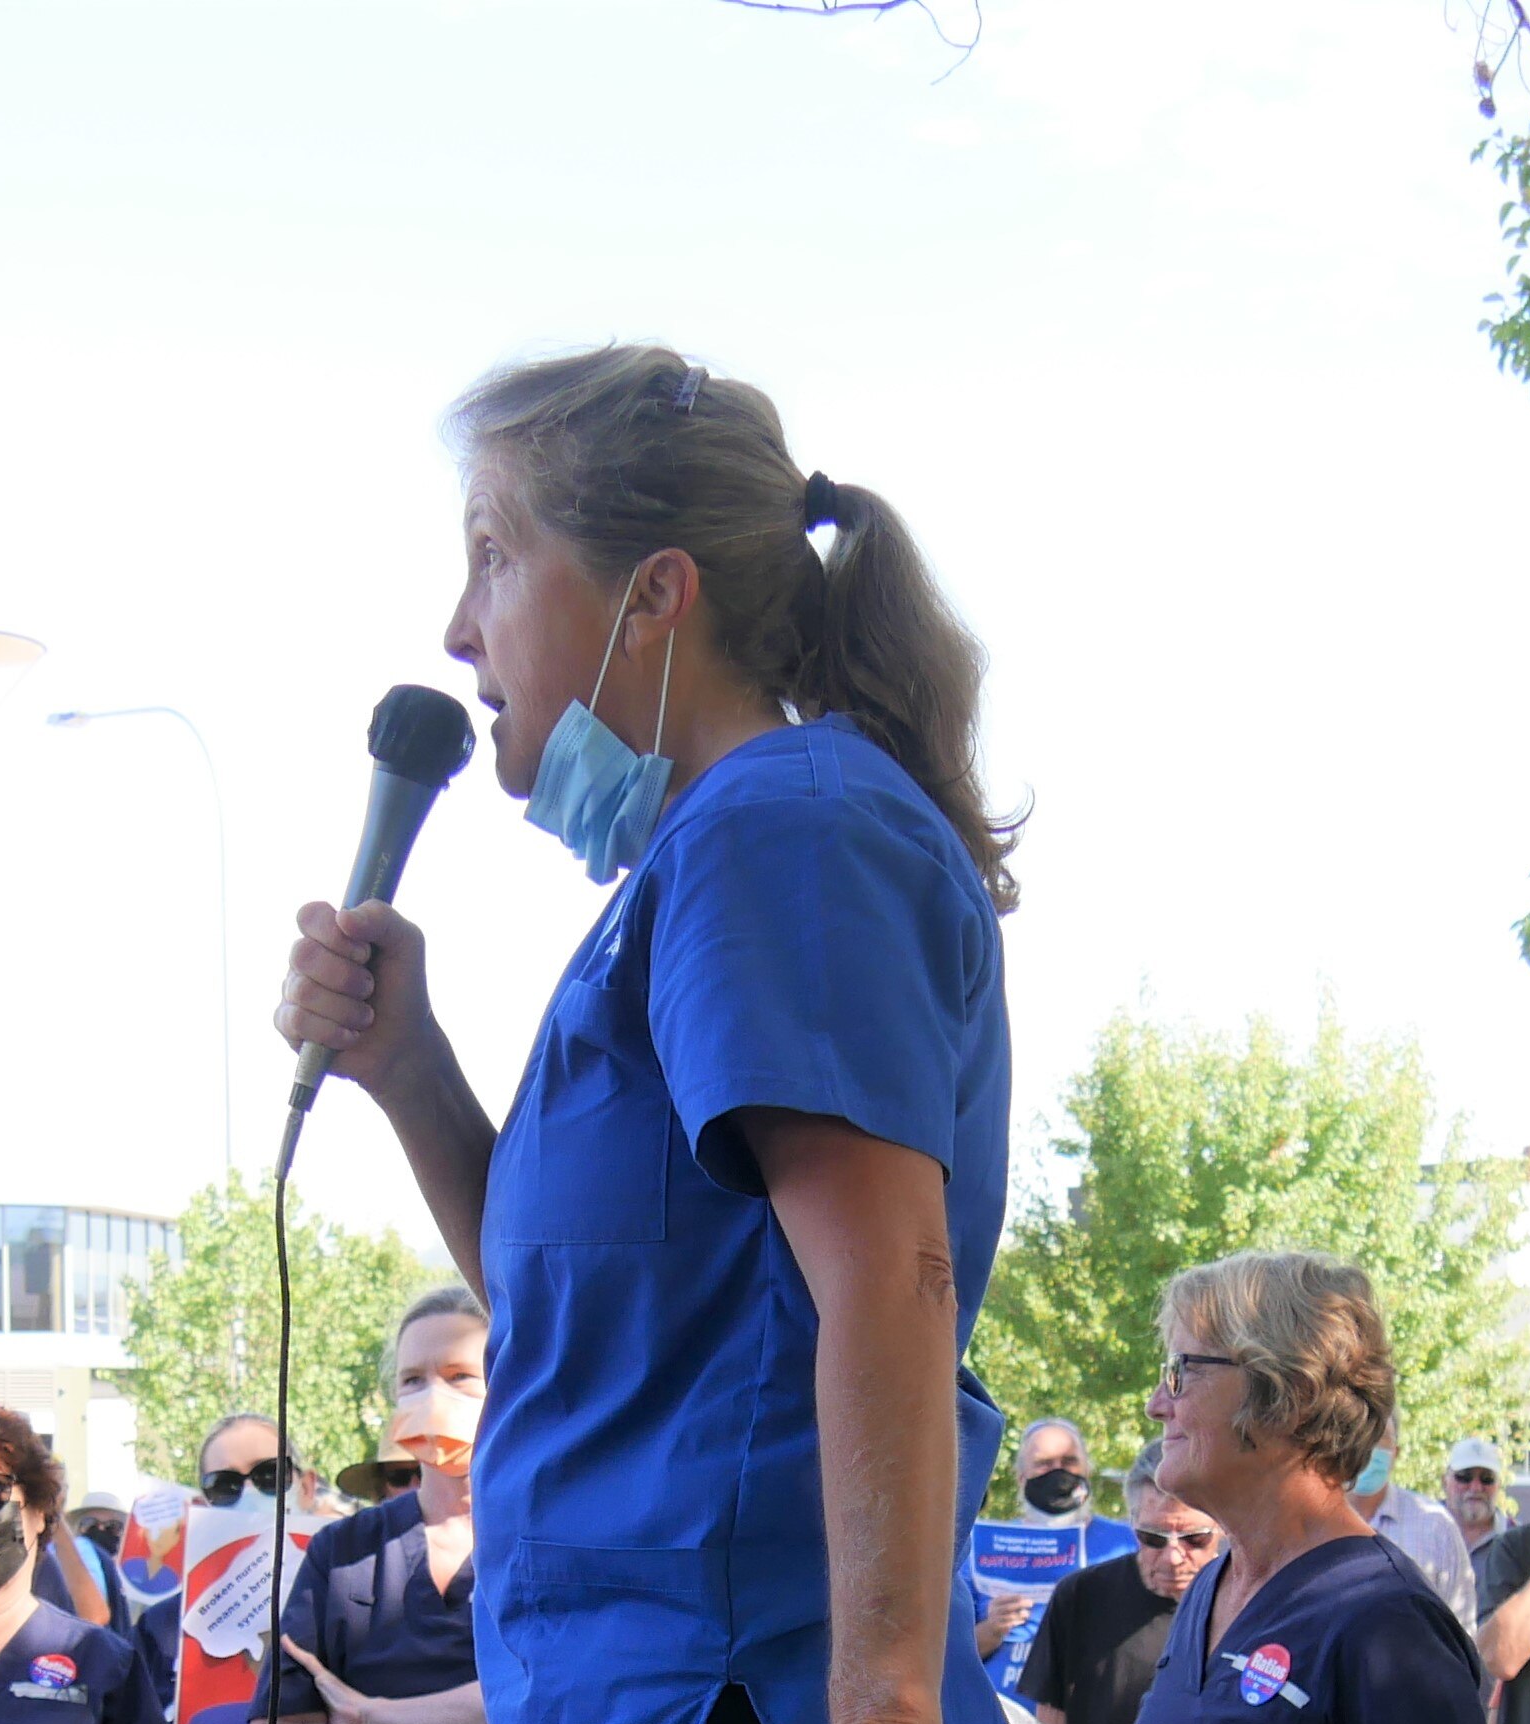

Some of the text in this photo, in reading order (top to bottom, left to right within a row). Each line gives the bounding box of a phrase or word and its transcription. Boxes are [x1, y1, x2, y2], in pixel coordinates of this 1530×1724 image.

[198, 1551, 269, 1616] Broken nurses
[207, 1602, 241, 1633] means
[249, 1571, 273, 1593] brok
